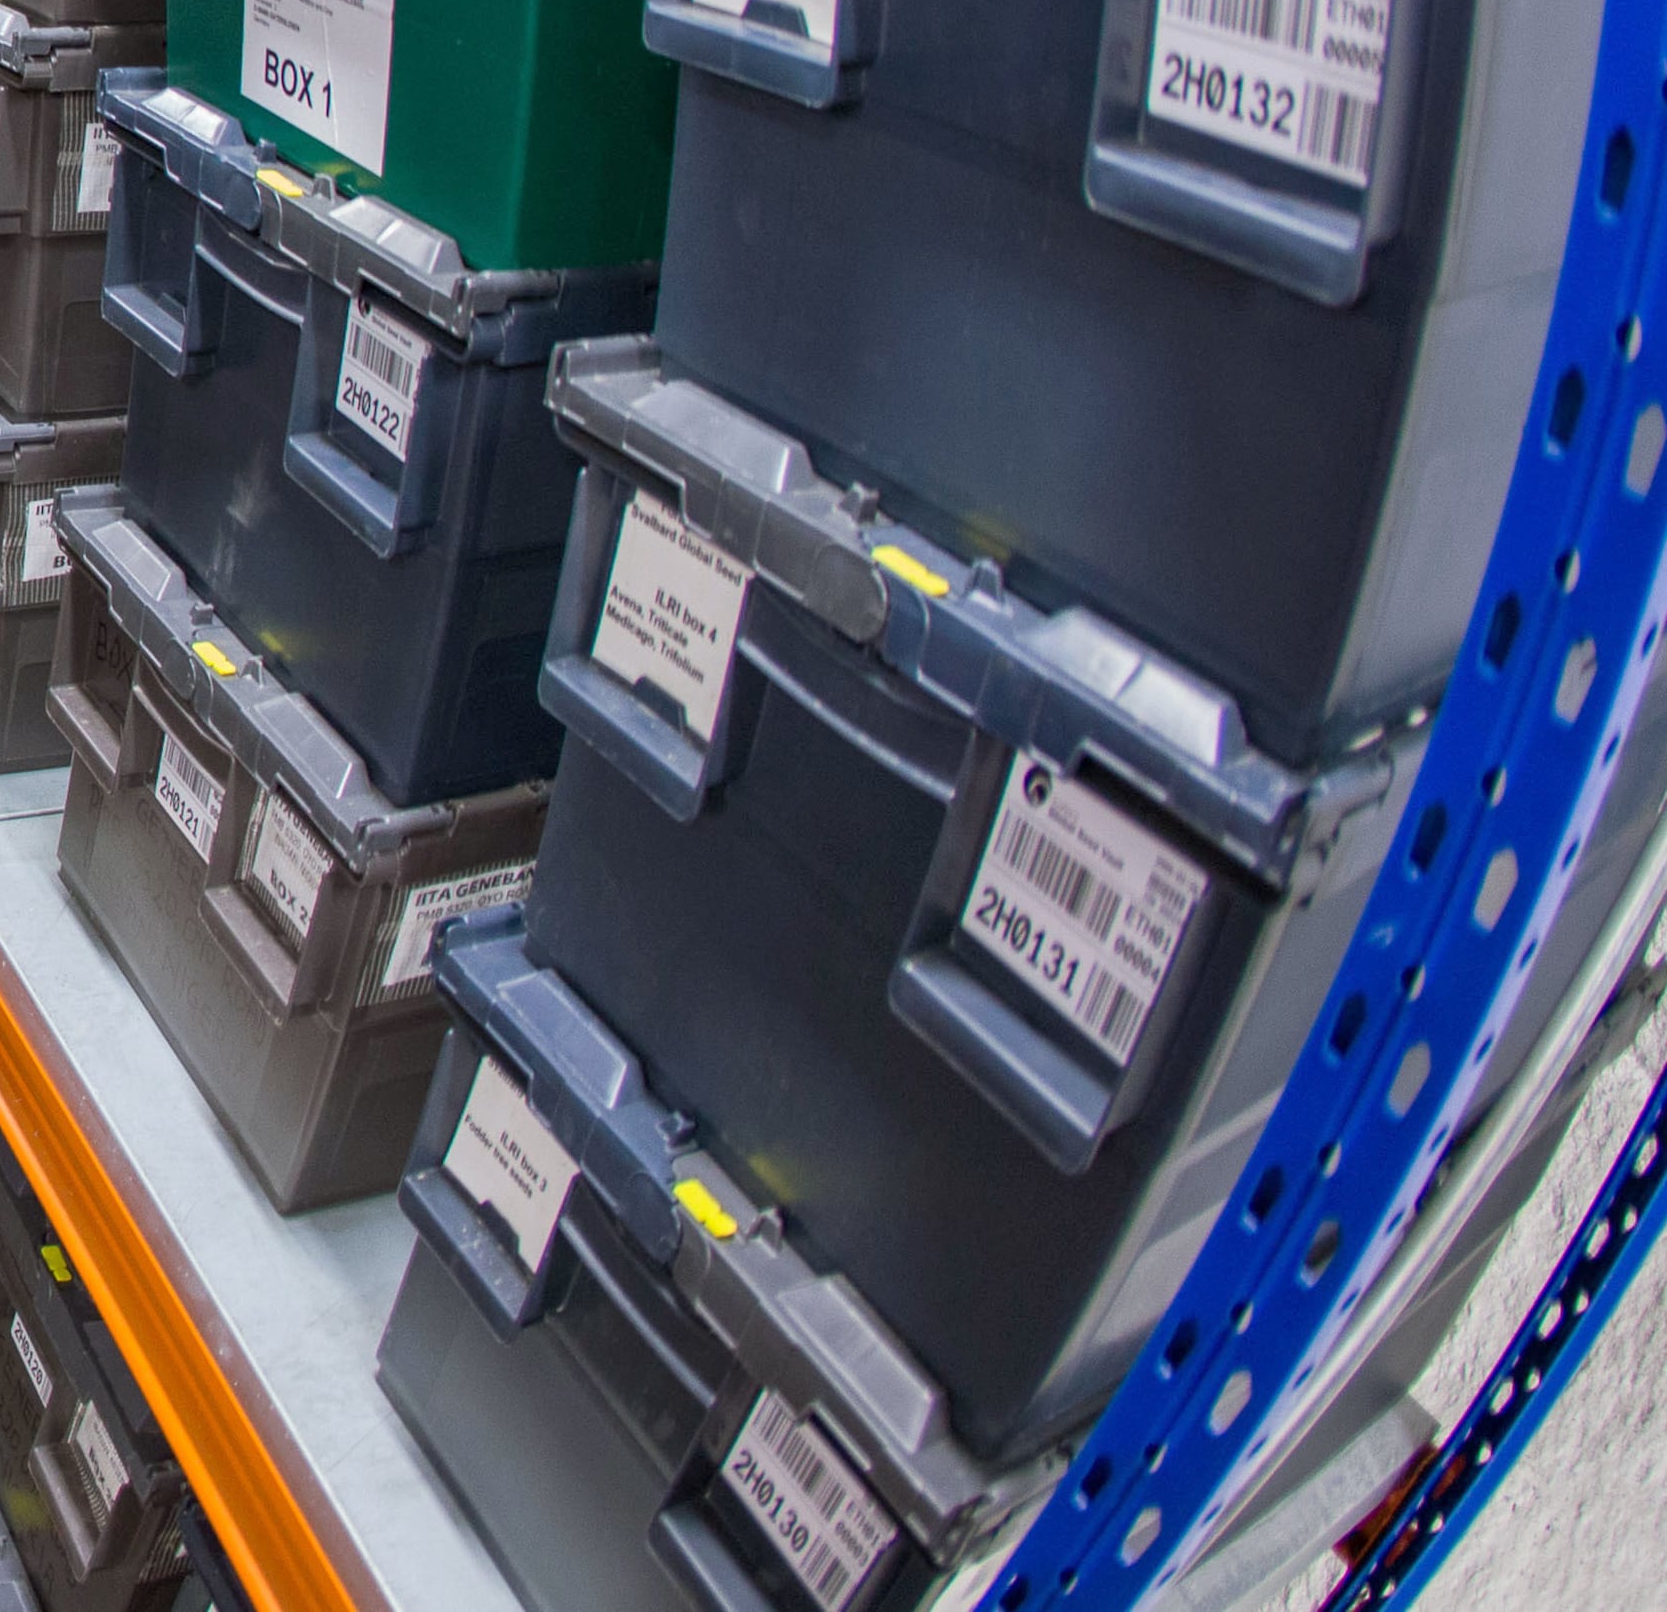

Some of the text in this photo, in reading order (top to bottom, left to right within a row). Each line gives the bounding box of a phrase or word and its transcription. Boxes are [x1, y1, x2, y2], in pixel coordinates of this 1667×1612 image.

[265, 47, 332, 118] BOX 1
[1161, 52, 1296, 138] 2H0132
[342, 376, 400, 440] 2H0122
[631, 504, 677, 543] Svalbard
[679, 536, 712, 565] Global
[715, 558, 742, 587] Seed
[605, 603, 705, 684] Medicago, Trifolium
[610, 584, 689, 648] Avena, Triticale
[655, 588, 717, 644] ILRI box 4
[158, 776, 200, 839] 2H0121
[268, 867, 298, 914] BOX
[415, 887, 451, 907] IITA
[417, 907, 443, 920] PMB
[974, 886, 1080, 999] 2H0131
[1113, 935, 1162, 986] 00004
[465, 1114, 534, 1200] Fodder tree seeds
[499, 1131, 548, 1193] ILRI box 3
[14, 1322, 43, 1385] 2H0120
[732, 1449, 809, 1554] 2H0130
